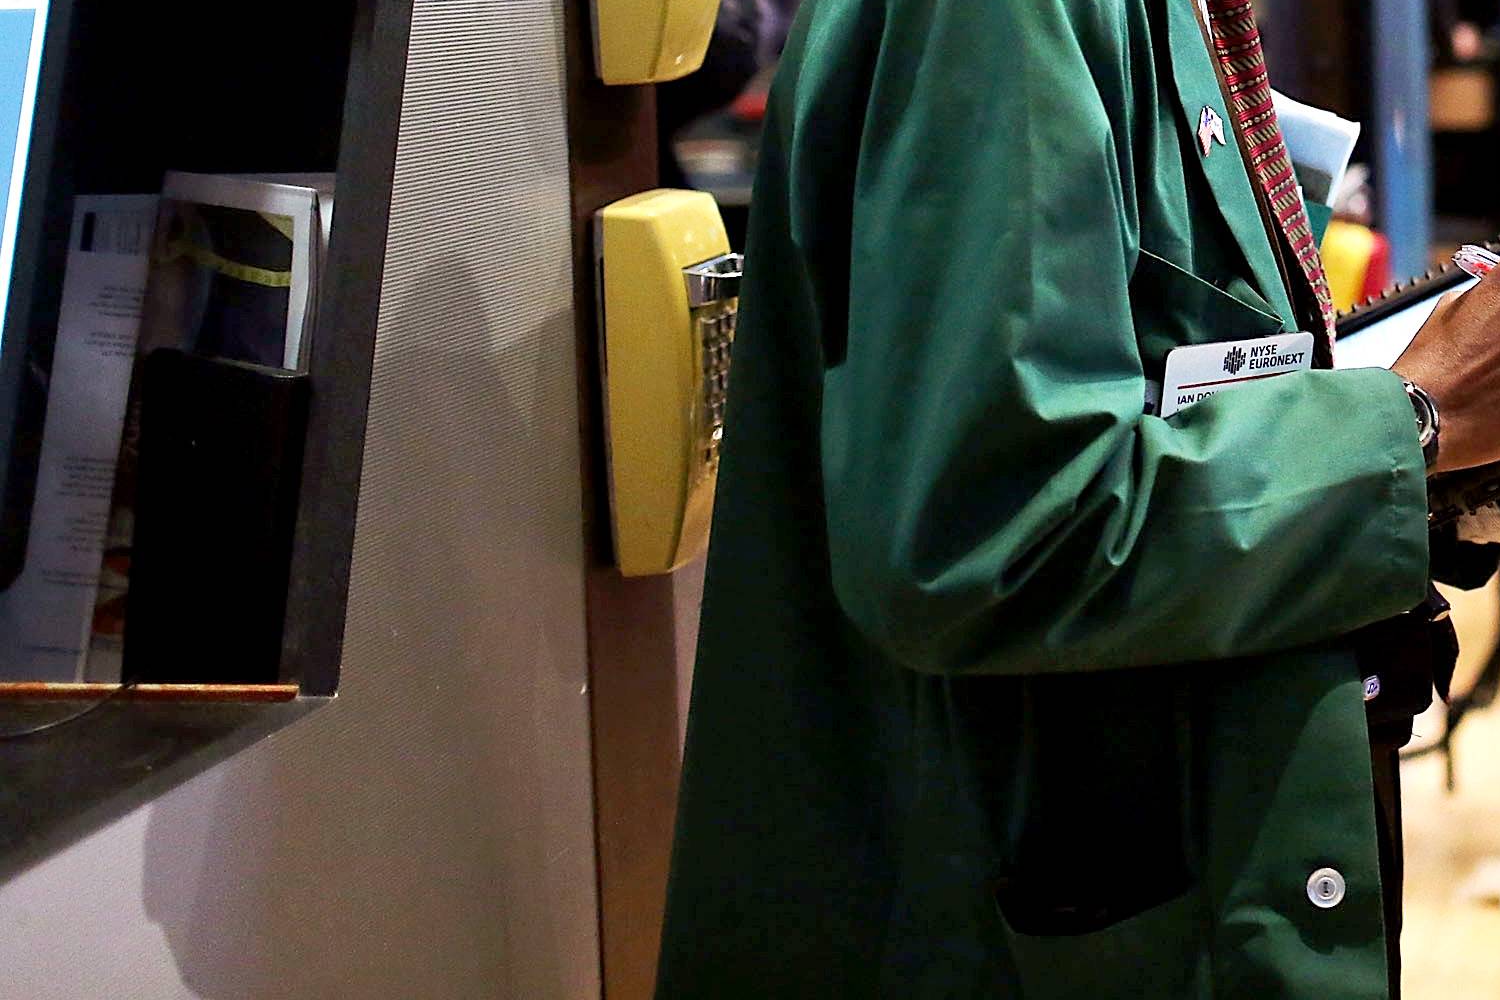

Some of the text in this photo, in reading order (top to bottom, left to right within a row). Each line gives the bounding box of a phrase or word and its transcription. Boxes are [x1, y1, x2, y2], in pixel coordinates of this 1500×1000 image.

[1250, 344, 1278, 358] NYSE
[1249, 352, 1305, 369] EURONEXT
[1177, 393, 1195, 405] IAN
